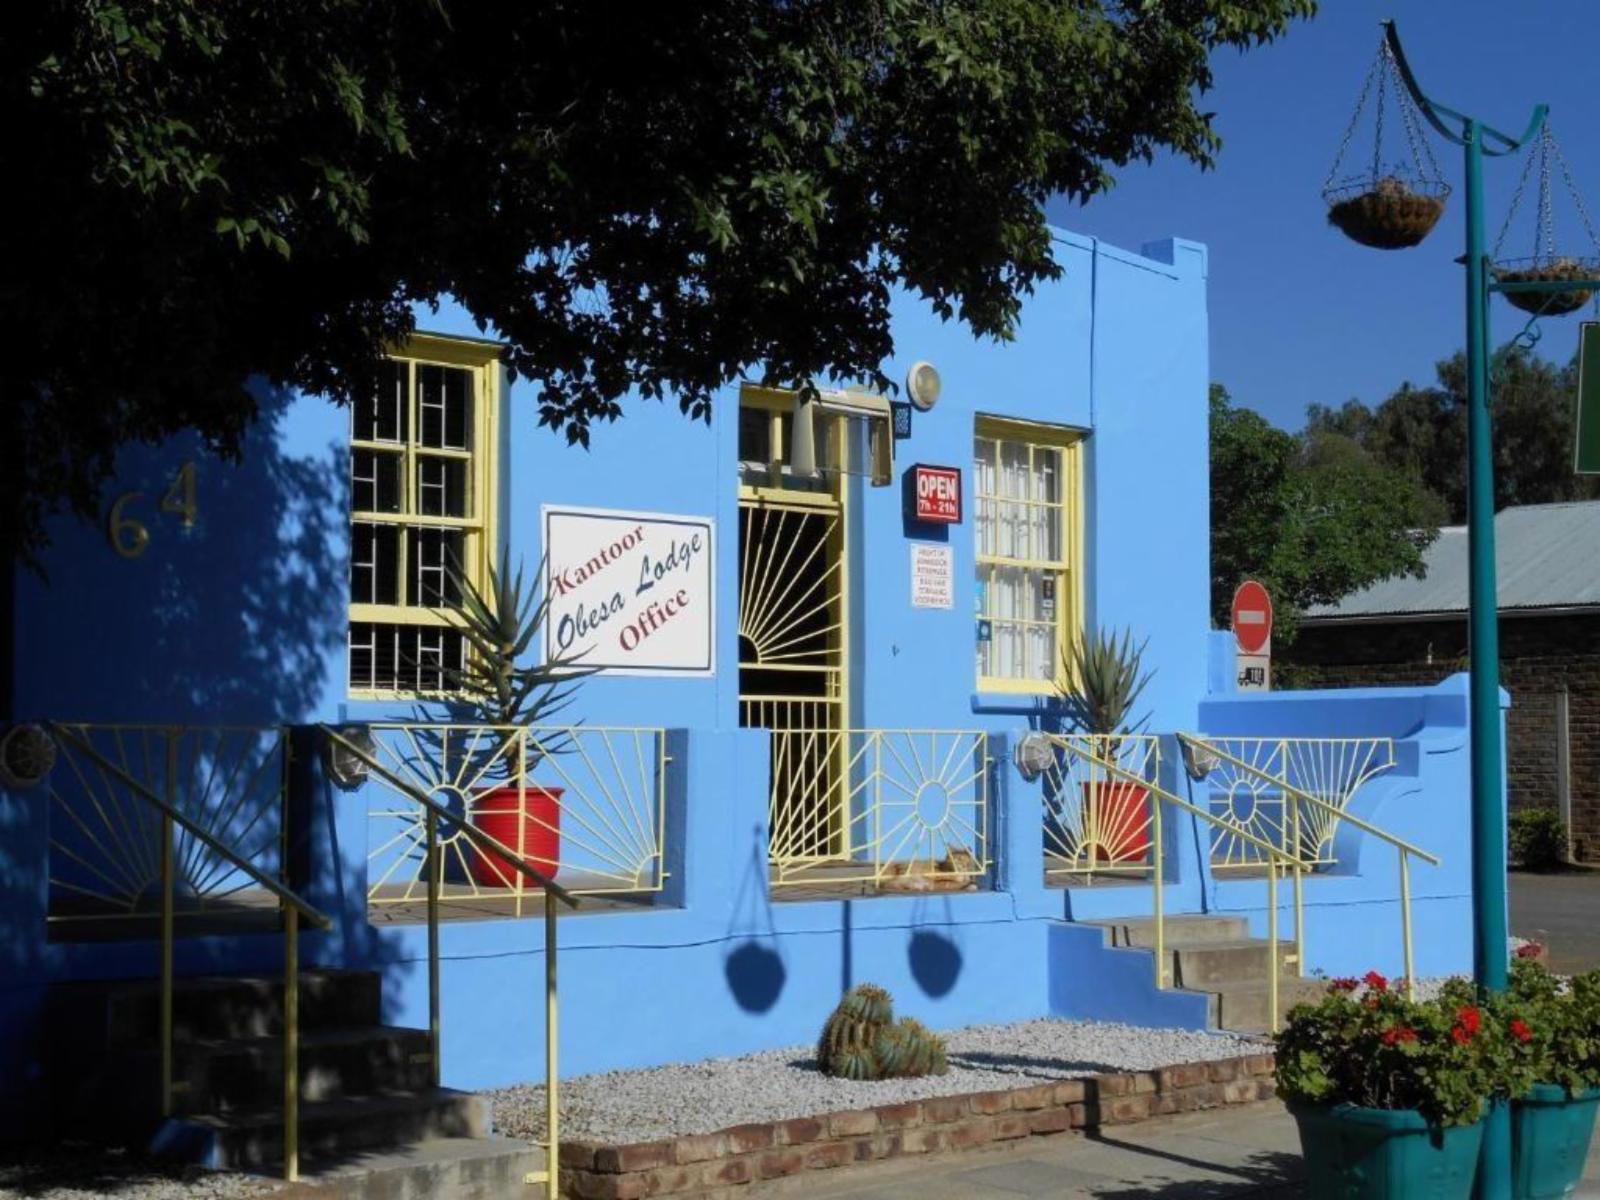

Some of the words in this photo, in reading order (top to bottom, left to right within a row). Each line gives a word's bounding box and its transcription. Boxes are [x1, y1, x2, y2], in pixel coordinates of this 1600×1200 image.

[109, 461, 197, 558] 64
[919, 474, 956, 501] OPEN
[919, 499, 932, 512] 7h
[938, 501, 956, 513] 21h
[552, 525, 646, 596] Kantoor
[557, 592, 625, 650] Obesa
[635, 533, 702, 597] Lodge
[619, 589, 690, 652] Office
